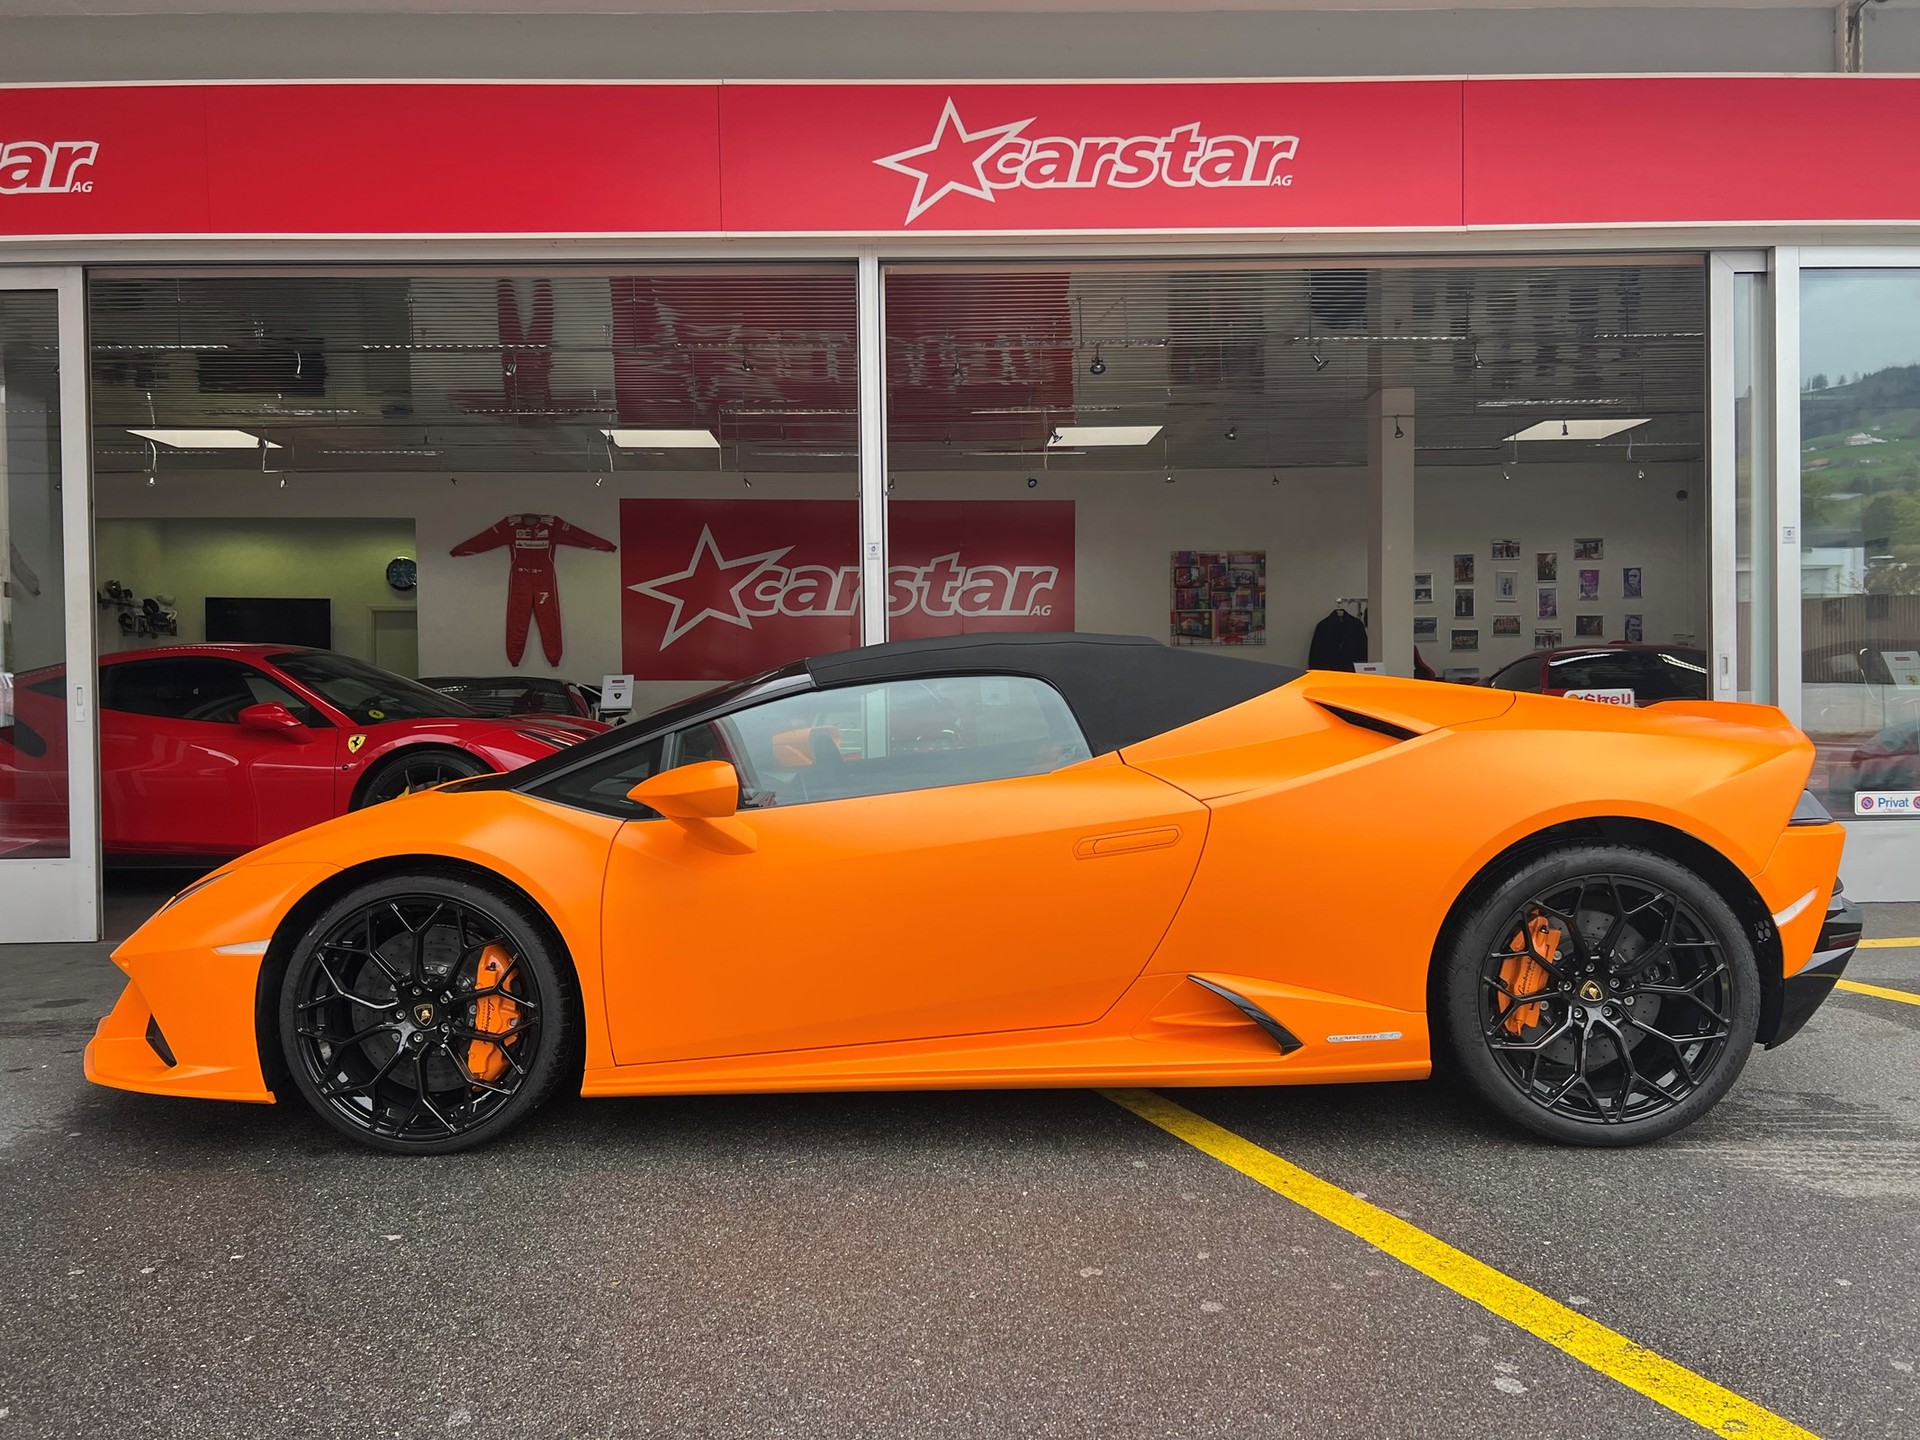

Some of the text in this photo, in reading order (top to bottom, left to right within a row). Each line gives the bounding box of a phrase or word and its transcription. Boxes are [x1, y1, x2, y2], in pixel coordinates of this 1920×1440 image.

[979, 121, 1300, 189] carstar AG
[71, 181, 94, 193] AG
[1030, 604, 1052, 617] AG
[1878, 797, 1909, 808] Privat
